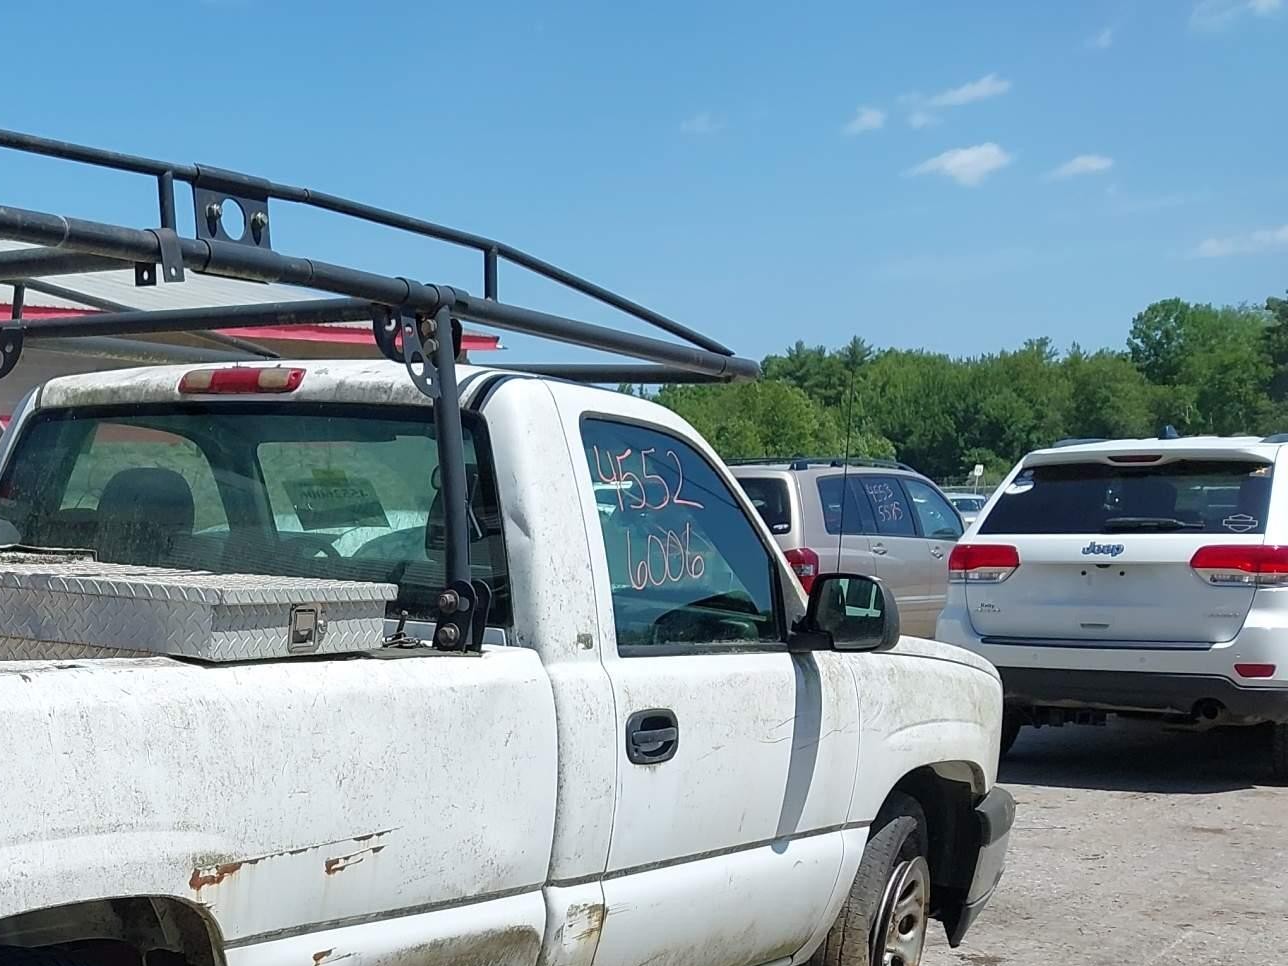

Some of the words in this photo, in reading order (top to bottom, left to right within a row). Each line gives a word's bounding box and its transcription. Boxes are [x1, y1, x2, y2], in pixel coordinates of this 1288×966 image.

[589, 445, 704, 512] 4552
[626, 522, 705, 590] 6006
[1081, 540, 1125, 557] Jeep
